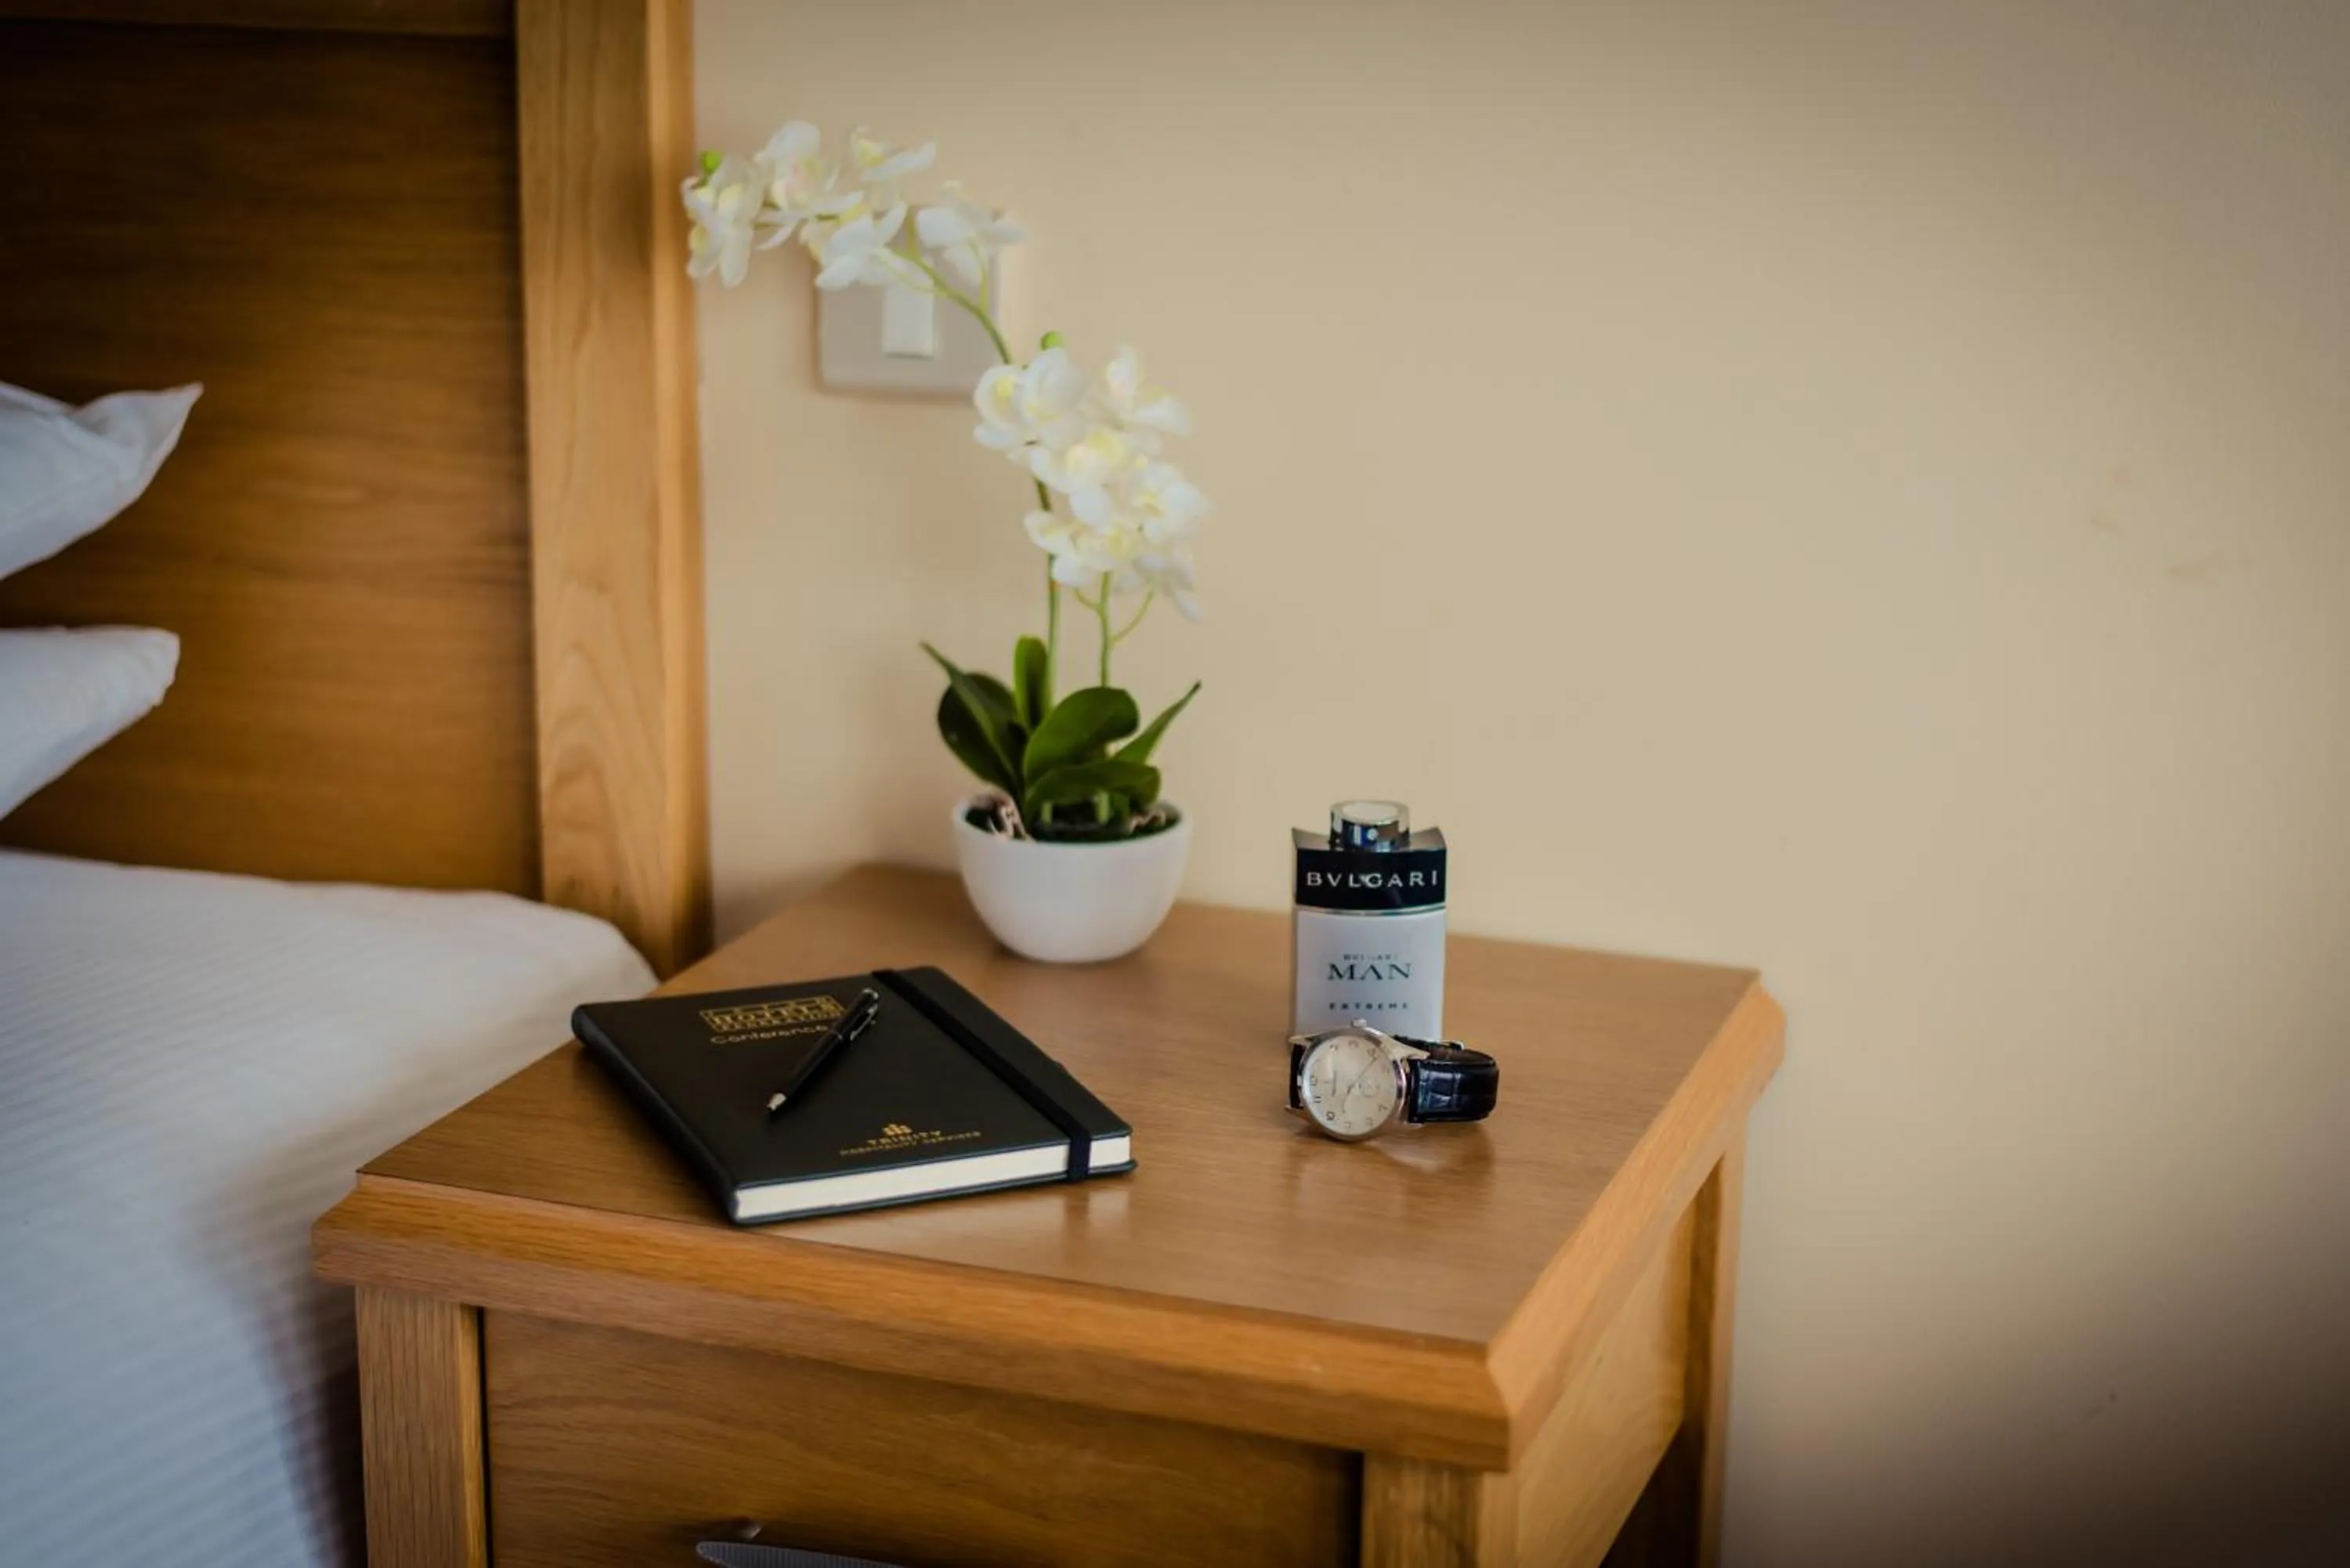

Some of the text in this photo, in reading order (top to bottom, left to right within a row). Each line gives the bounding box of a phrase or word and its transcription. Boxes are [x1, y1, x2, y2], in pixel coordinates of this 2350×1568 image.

[1307, 870, 1437, 888] BVLGARI
[1328, 963, 1412, 981] MAN
[710, 1024, 829, 1045] Conference
[866, 1130, 941, 1145] TRINITY
